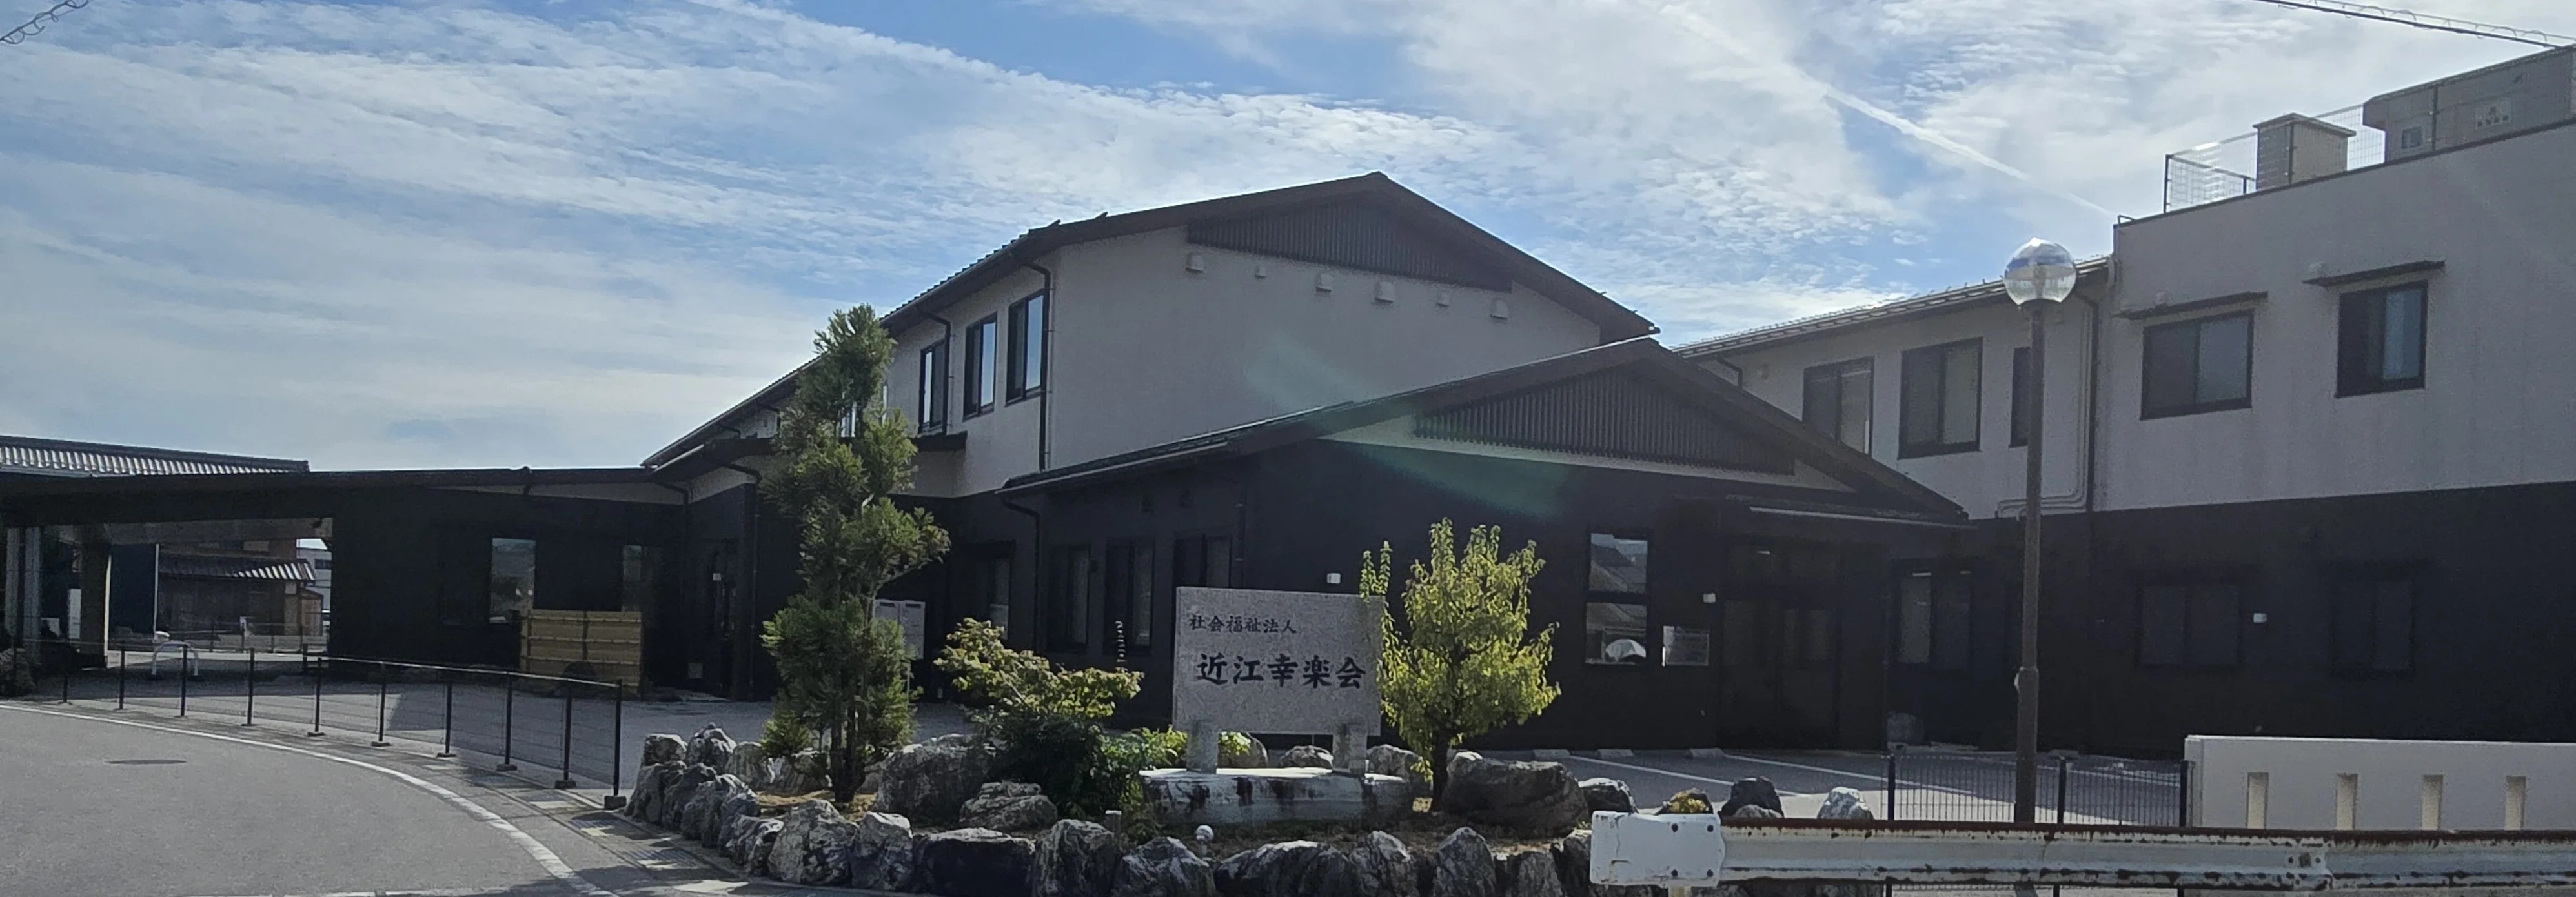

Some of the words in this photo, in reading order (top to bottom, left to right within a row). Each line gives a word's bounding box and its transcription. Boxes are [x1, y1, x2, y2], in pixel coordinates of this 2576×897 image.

[1189, 614, 1297, 634] 社会福祉法人
[1195, 652, 1366, 689] 近江幸楽会
